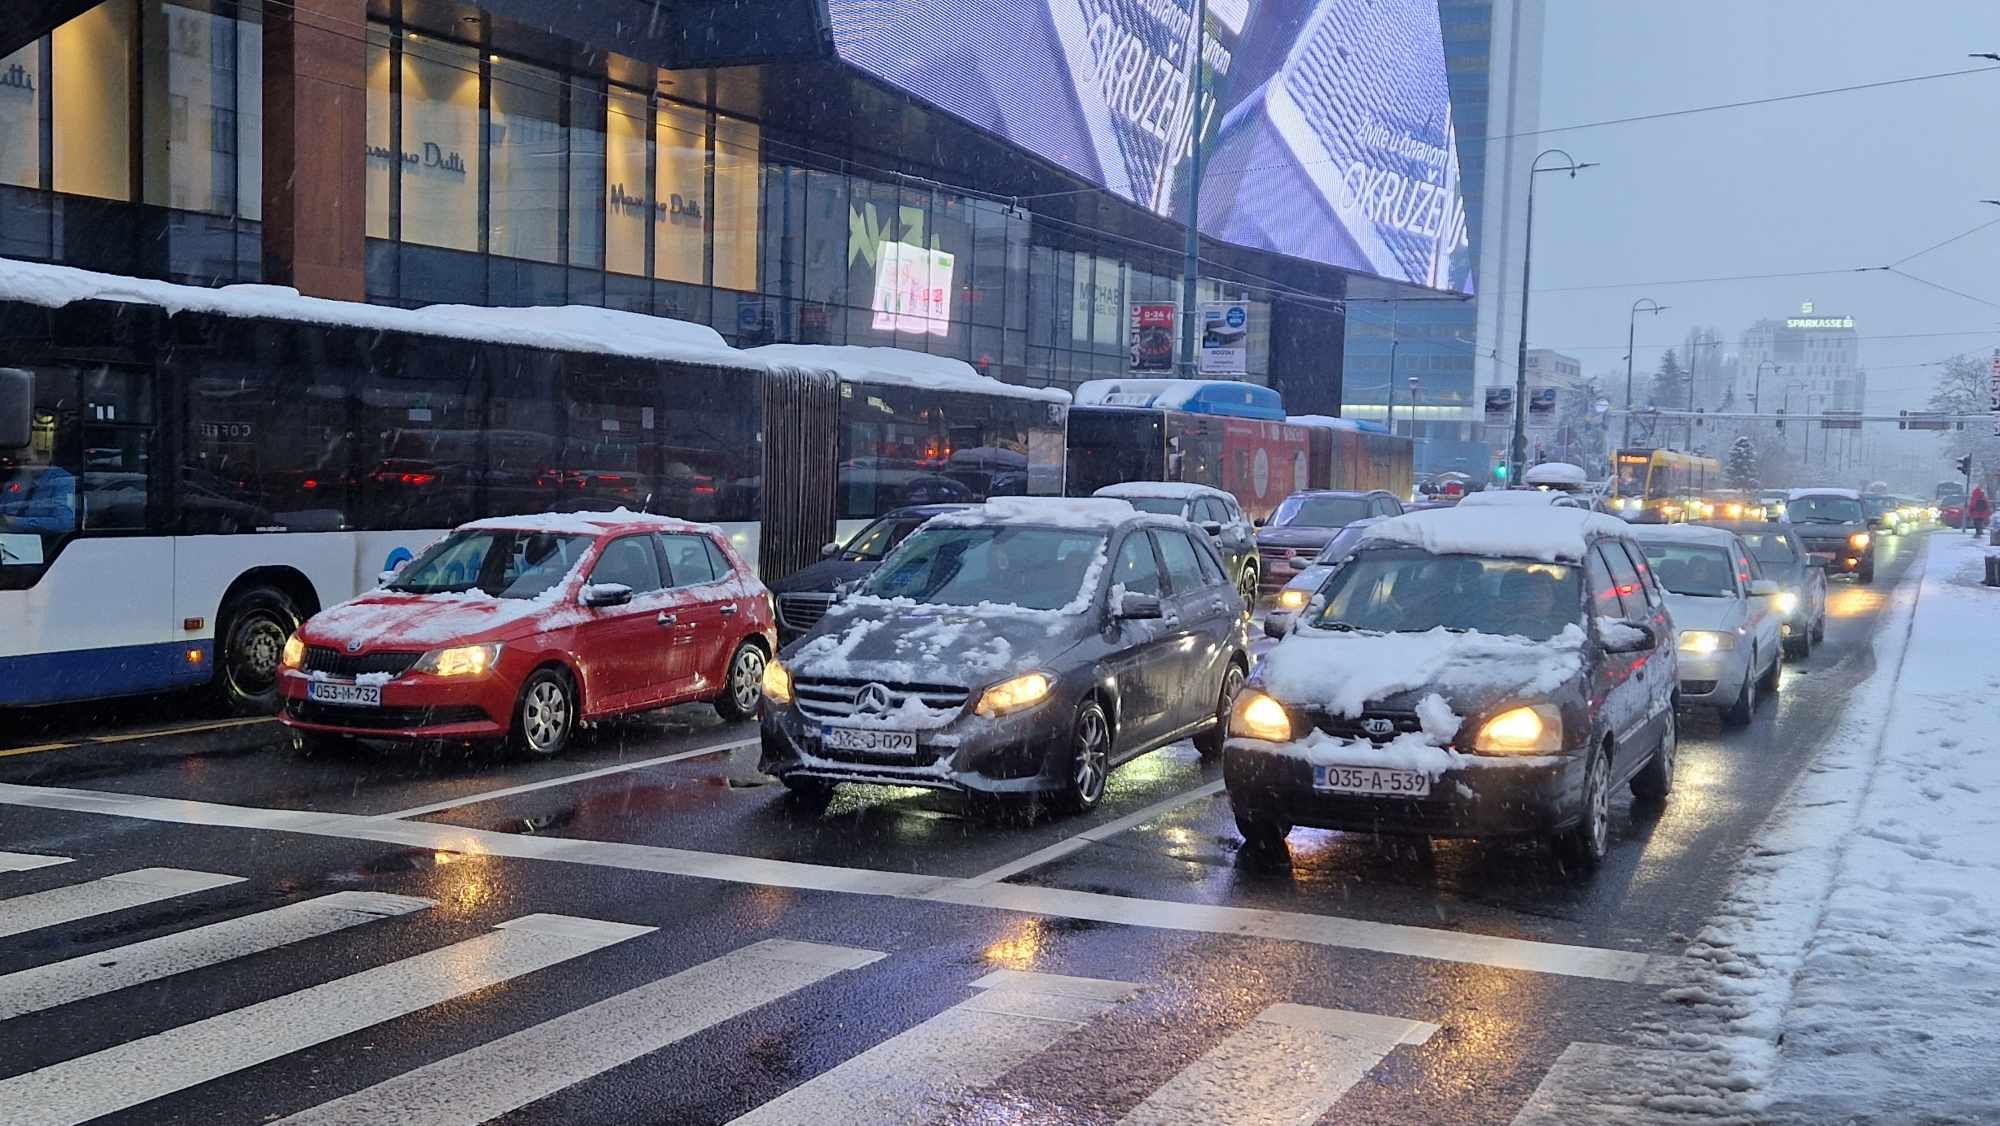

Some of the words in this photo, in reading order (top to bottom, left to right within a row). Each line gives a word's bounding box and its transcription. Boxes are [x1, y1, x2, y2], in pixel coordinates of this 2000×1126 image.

[423, 141, 466, 174] Dutti
[1129, 303, 1141, 367] CASINO
[1786, 319, 1842, 328] SPARKASSE
[1328, 768, 1426, 792] 035-A-539
